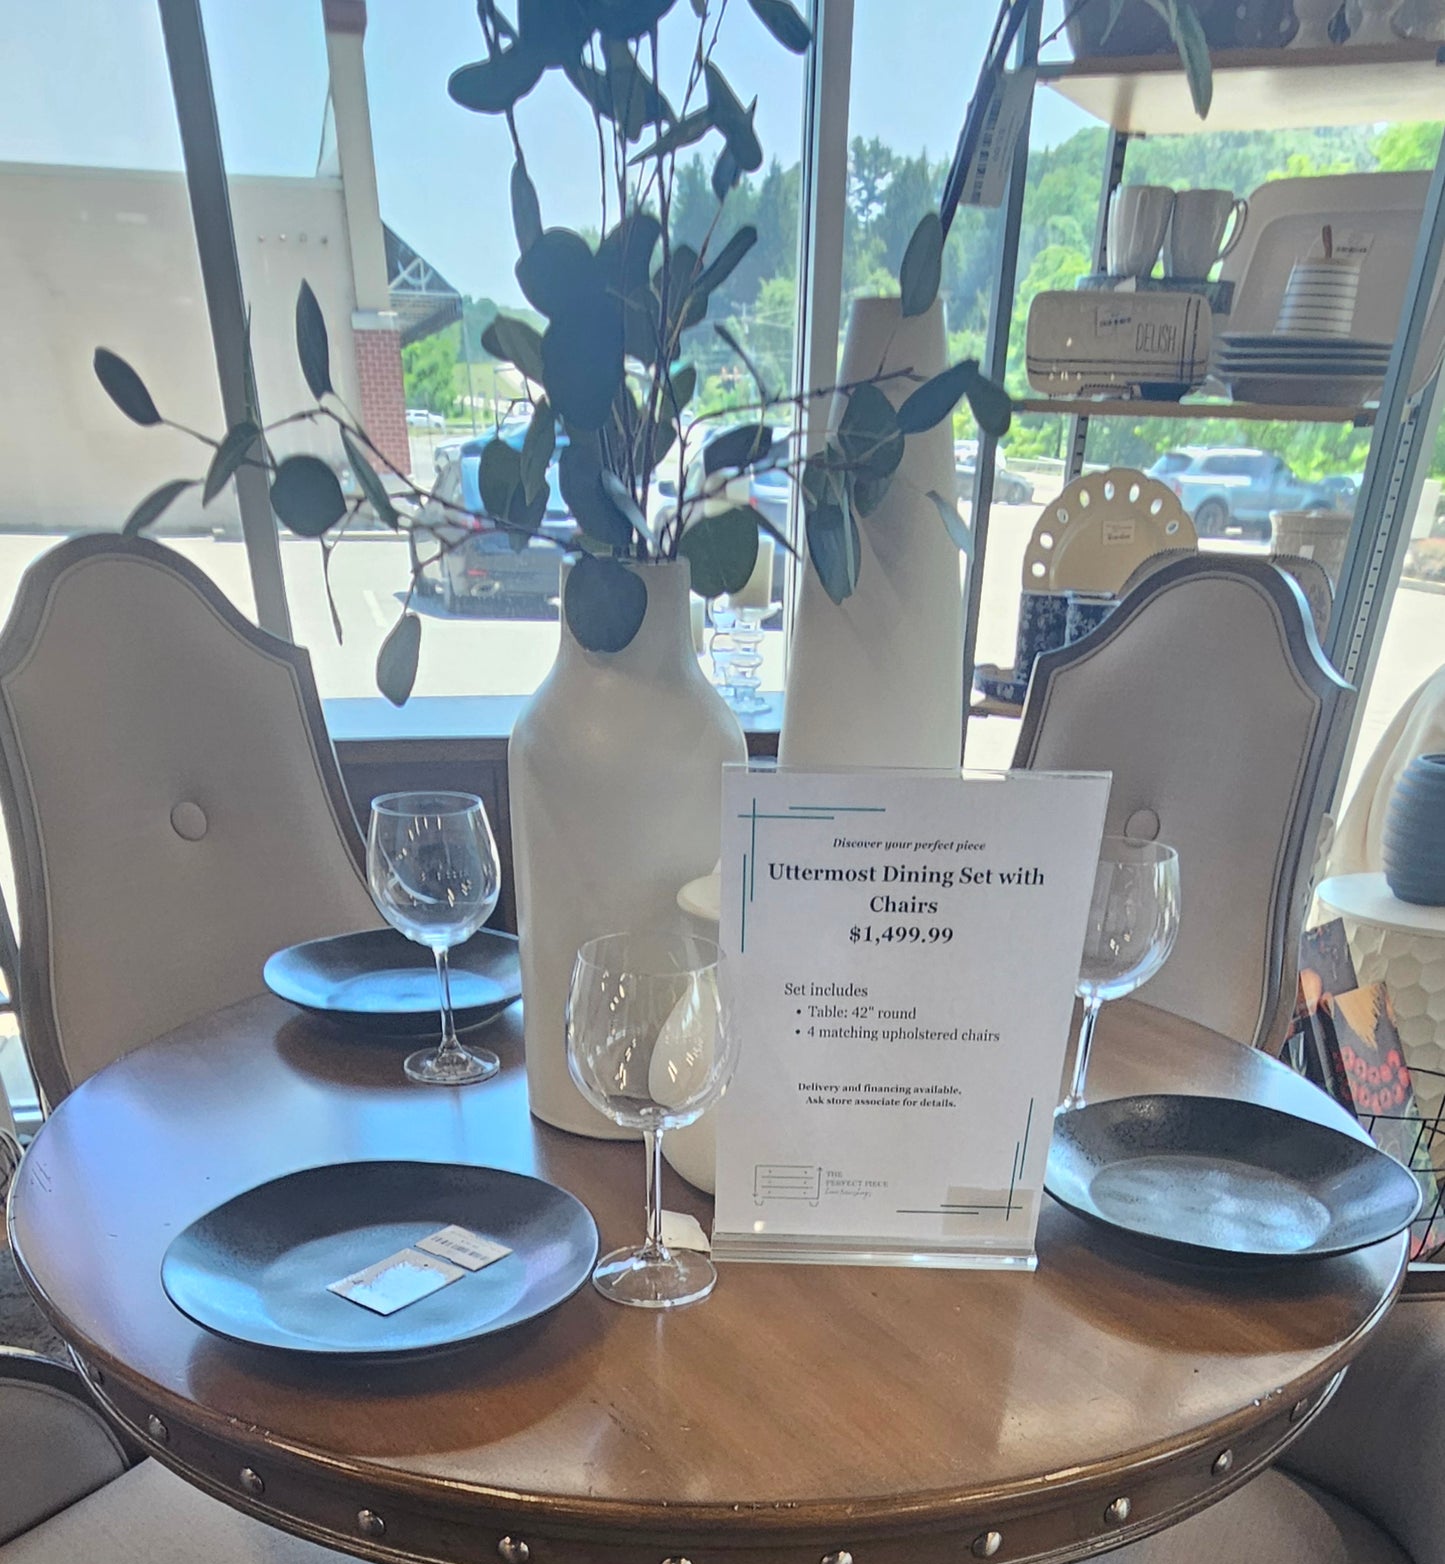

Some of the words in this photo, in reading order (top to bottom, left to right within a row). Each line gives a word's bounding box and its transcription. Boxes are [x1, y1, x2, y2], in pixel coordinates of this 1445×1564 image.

[1135, 322, 1178, 353] DELISH
[832, 837, 883, 849] Discover
[885, 840, 913, 851] your
[913, 839, 955, 852] perfect
[955, 840, 986, 853] piece
[767, 862, 877, 883] Uttermost
[881, 863, 955, 888] Dining
[958, 866, 994, 885] Set
[998, 866, 1046, 887] with
[869, 894, 939, 915] Chairs
[849, 924, 954, 946] $1,499.99
[784, 982, 806, 997] Set
[810, 981, 869, 998] includes
[807, 1004, 848, 1019] Table:
[851, 1005, 875, 1019] 42"
[877, 1005, 917, 1020] round
[806, 1025, 815, 1038] 4
[818, 1024, 879, 1042] matching
[881, 1026, 959, 1043] upholstered
[960, 1028, 1001, 1042] chairs
[798, 1082, 840, 1094] Delivery
[842, 1083, 862, 1093] and
[863, 1084, 912, 1096] financing
[913, 1085, 963, 1096] available.
[805, 1096, 825, 1105] Ask
[826, 1097, 853, 1105] store
[854, 1097, 901, 1107] associate
[902, 1098, 918, 1107] for
[919, 1098, 957, 1108] details.
